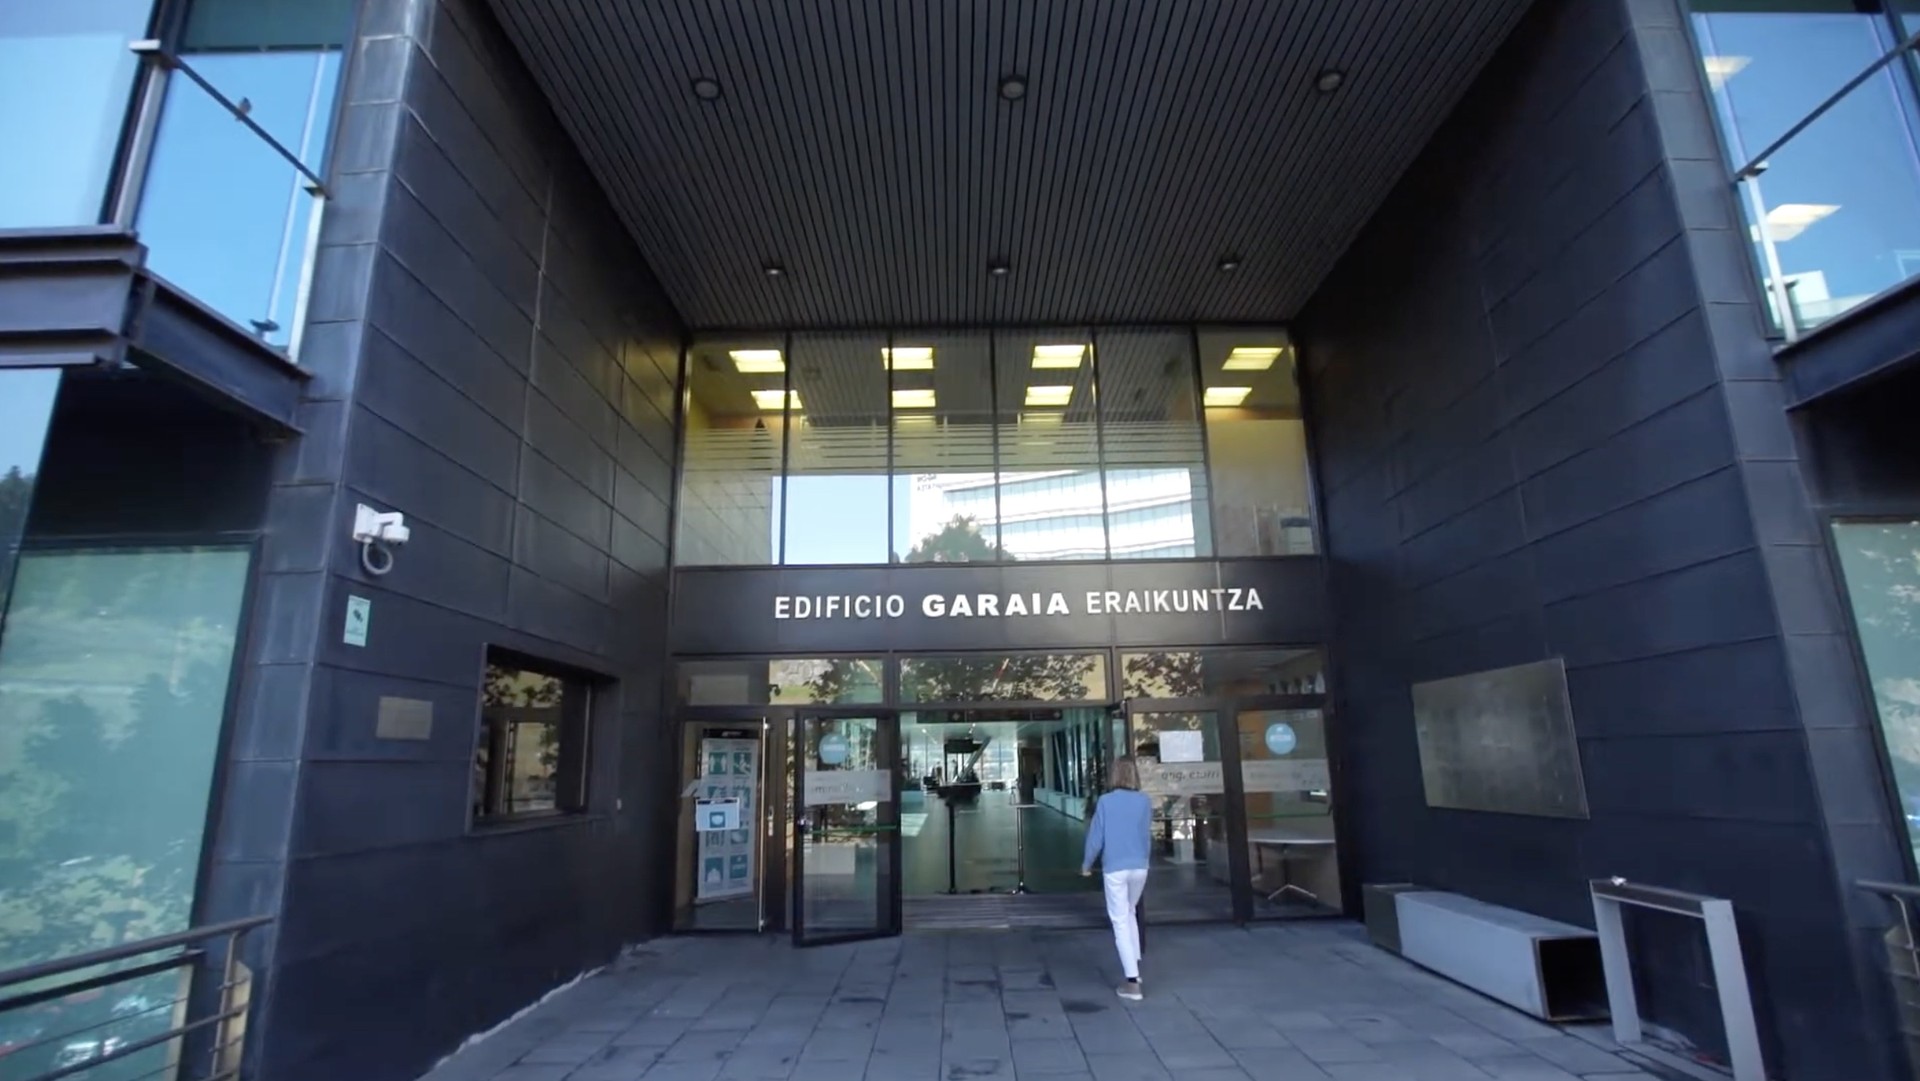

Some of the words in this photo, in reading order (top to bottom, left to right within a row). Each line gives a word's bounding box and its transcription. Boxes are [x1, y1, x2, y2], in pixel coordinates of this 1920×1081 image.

[774, 594, 905, 620] EDIFICIO
[921, 591, 1071, 618] GARAIA
[1085, 587, 1264, 615] ERAIKUNTZA
